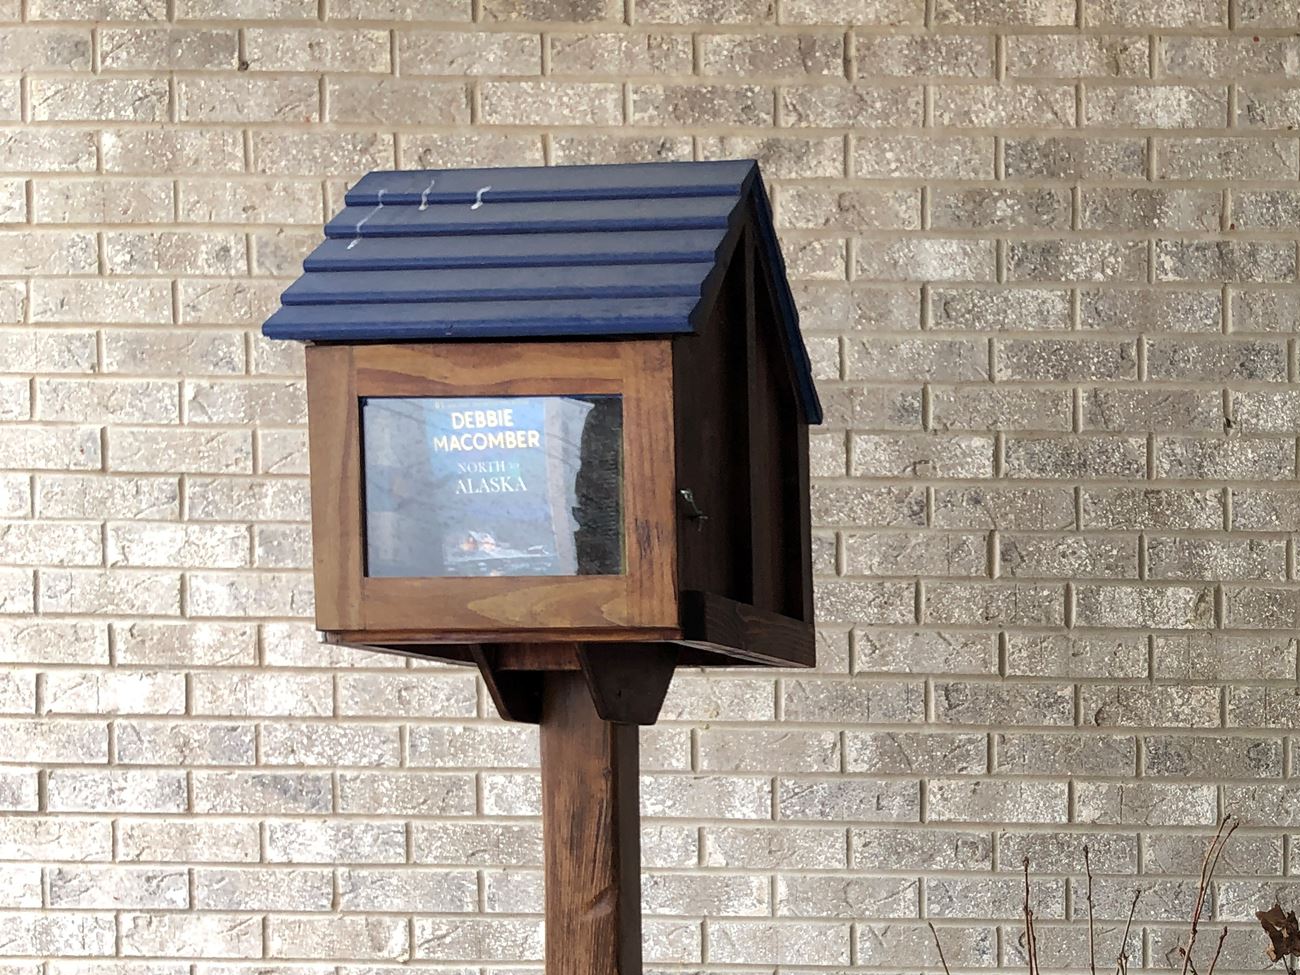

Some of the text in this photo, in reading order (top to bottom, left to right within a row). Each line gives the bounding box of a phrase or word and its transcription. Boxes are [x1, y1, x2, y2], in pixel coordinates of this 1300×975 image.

[451, 408, 514, 430] DEBBIE
[433, 430, 540, 452] MACOMBER
[457, 460, 505, 473] NORTH
[456, 476, 528, 494] ALASKA
